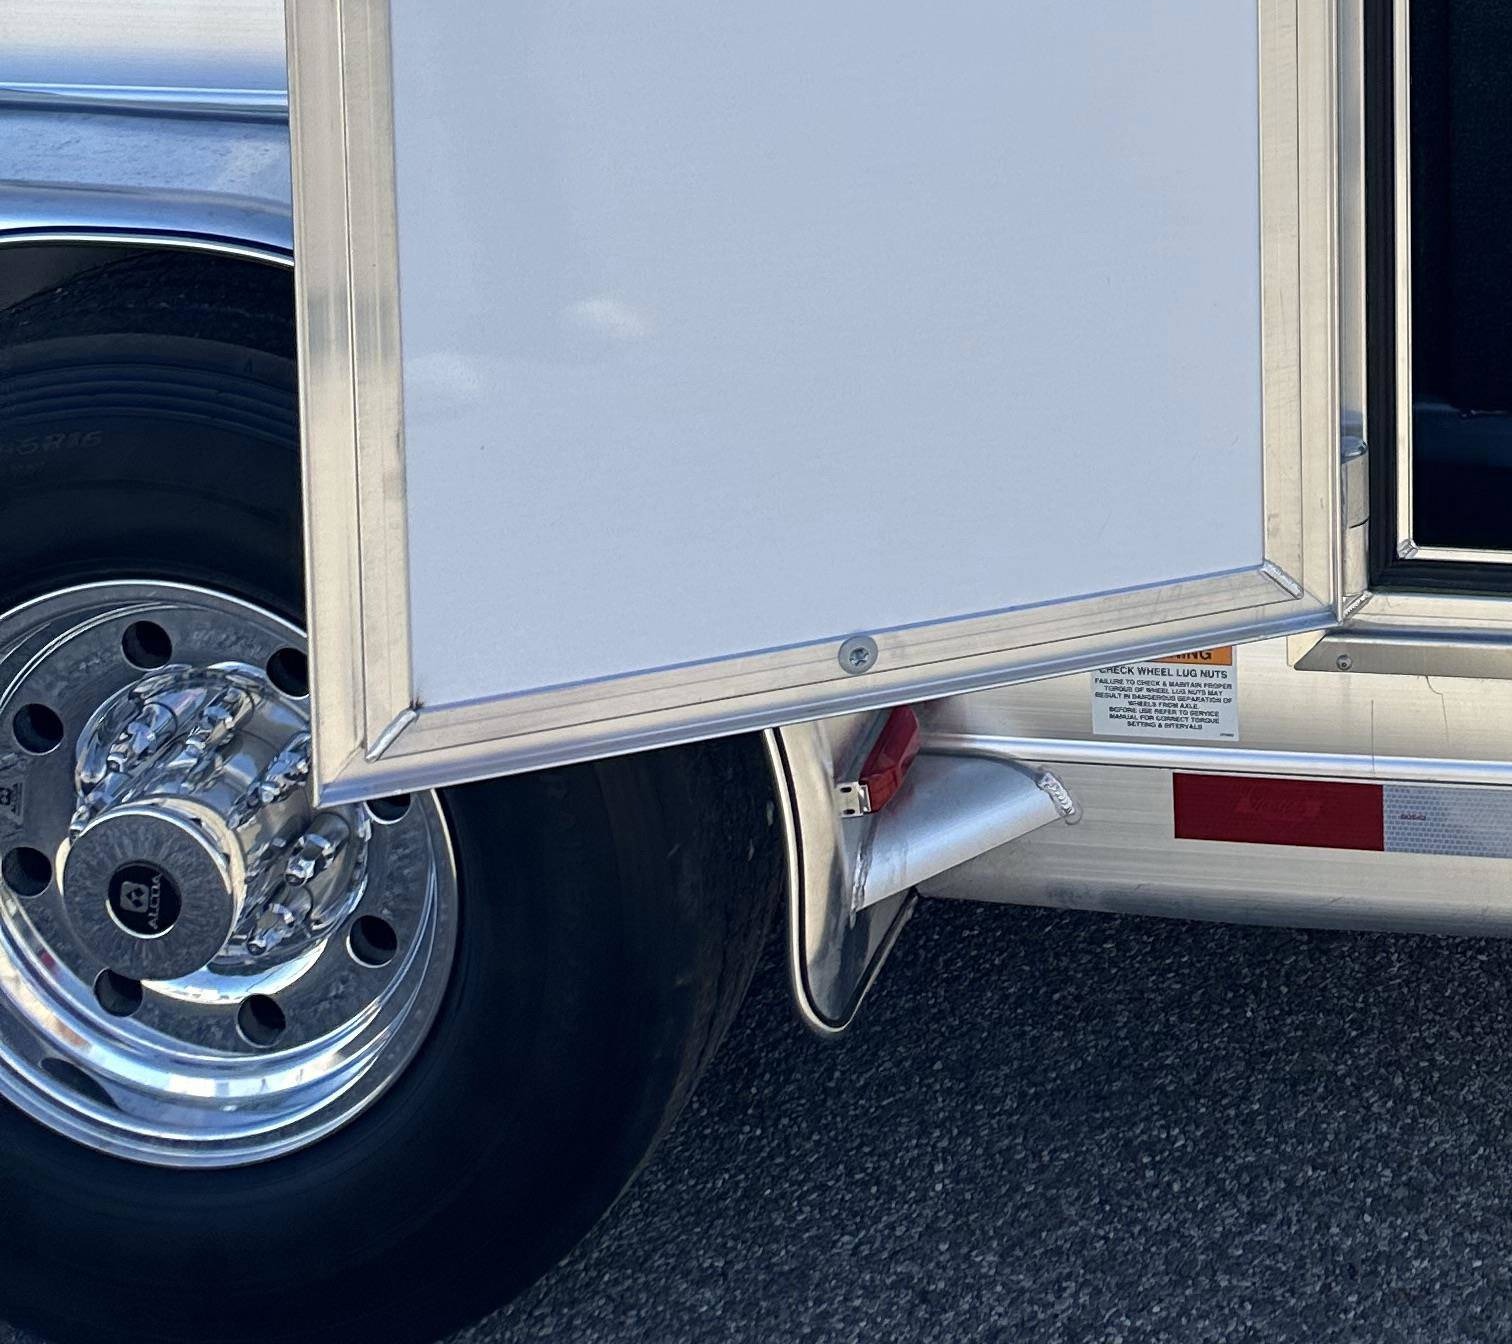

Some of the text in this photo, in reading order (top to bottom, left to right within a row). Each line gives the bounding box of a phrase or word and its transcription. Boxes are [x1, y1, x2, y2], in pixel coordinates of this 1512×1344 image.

[1099, 665, 1228, 679] CHECK WHEEL LUG NUTS
[1104, 685, 1132, 693] TORQUE
[148, 872, 162, 930] ALCOA
